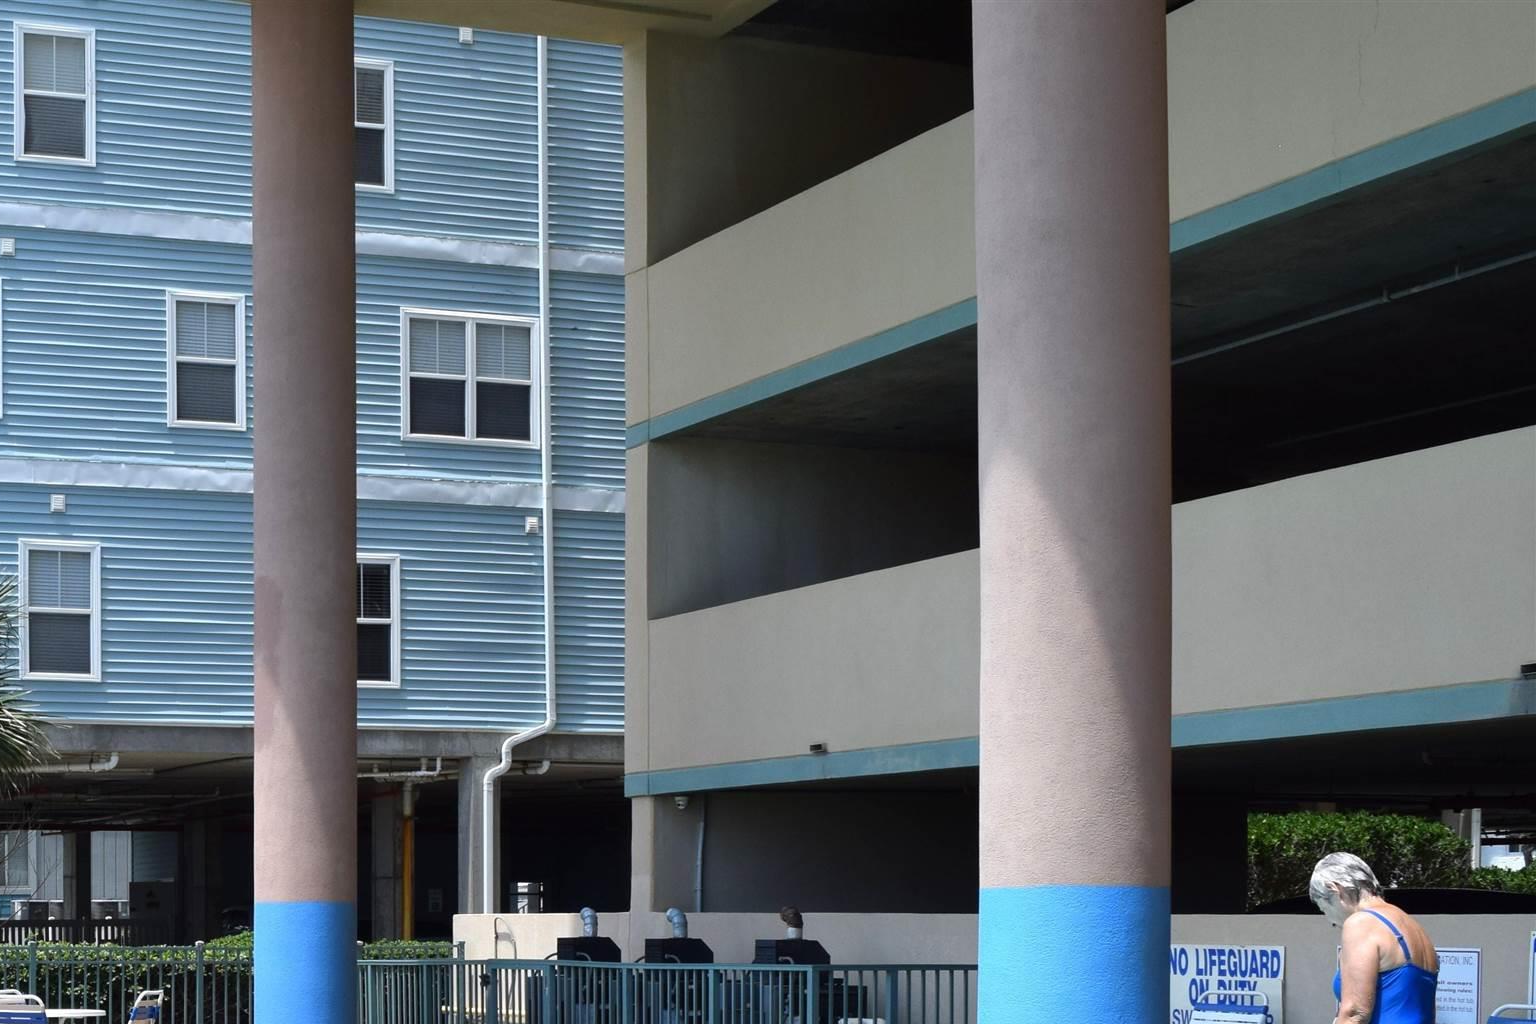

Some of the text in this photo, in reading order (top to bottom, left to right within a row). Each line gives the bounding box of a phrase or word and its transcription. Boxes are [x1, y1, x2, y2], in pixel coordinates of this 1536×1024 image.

[1170, 947, 1281, 979] NO LIFEGUARD
[1217, 979, 1258, 1006] DUTY
